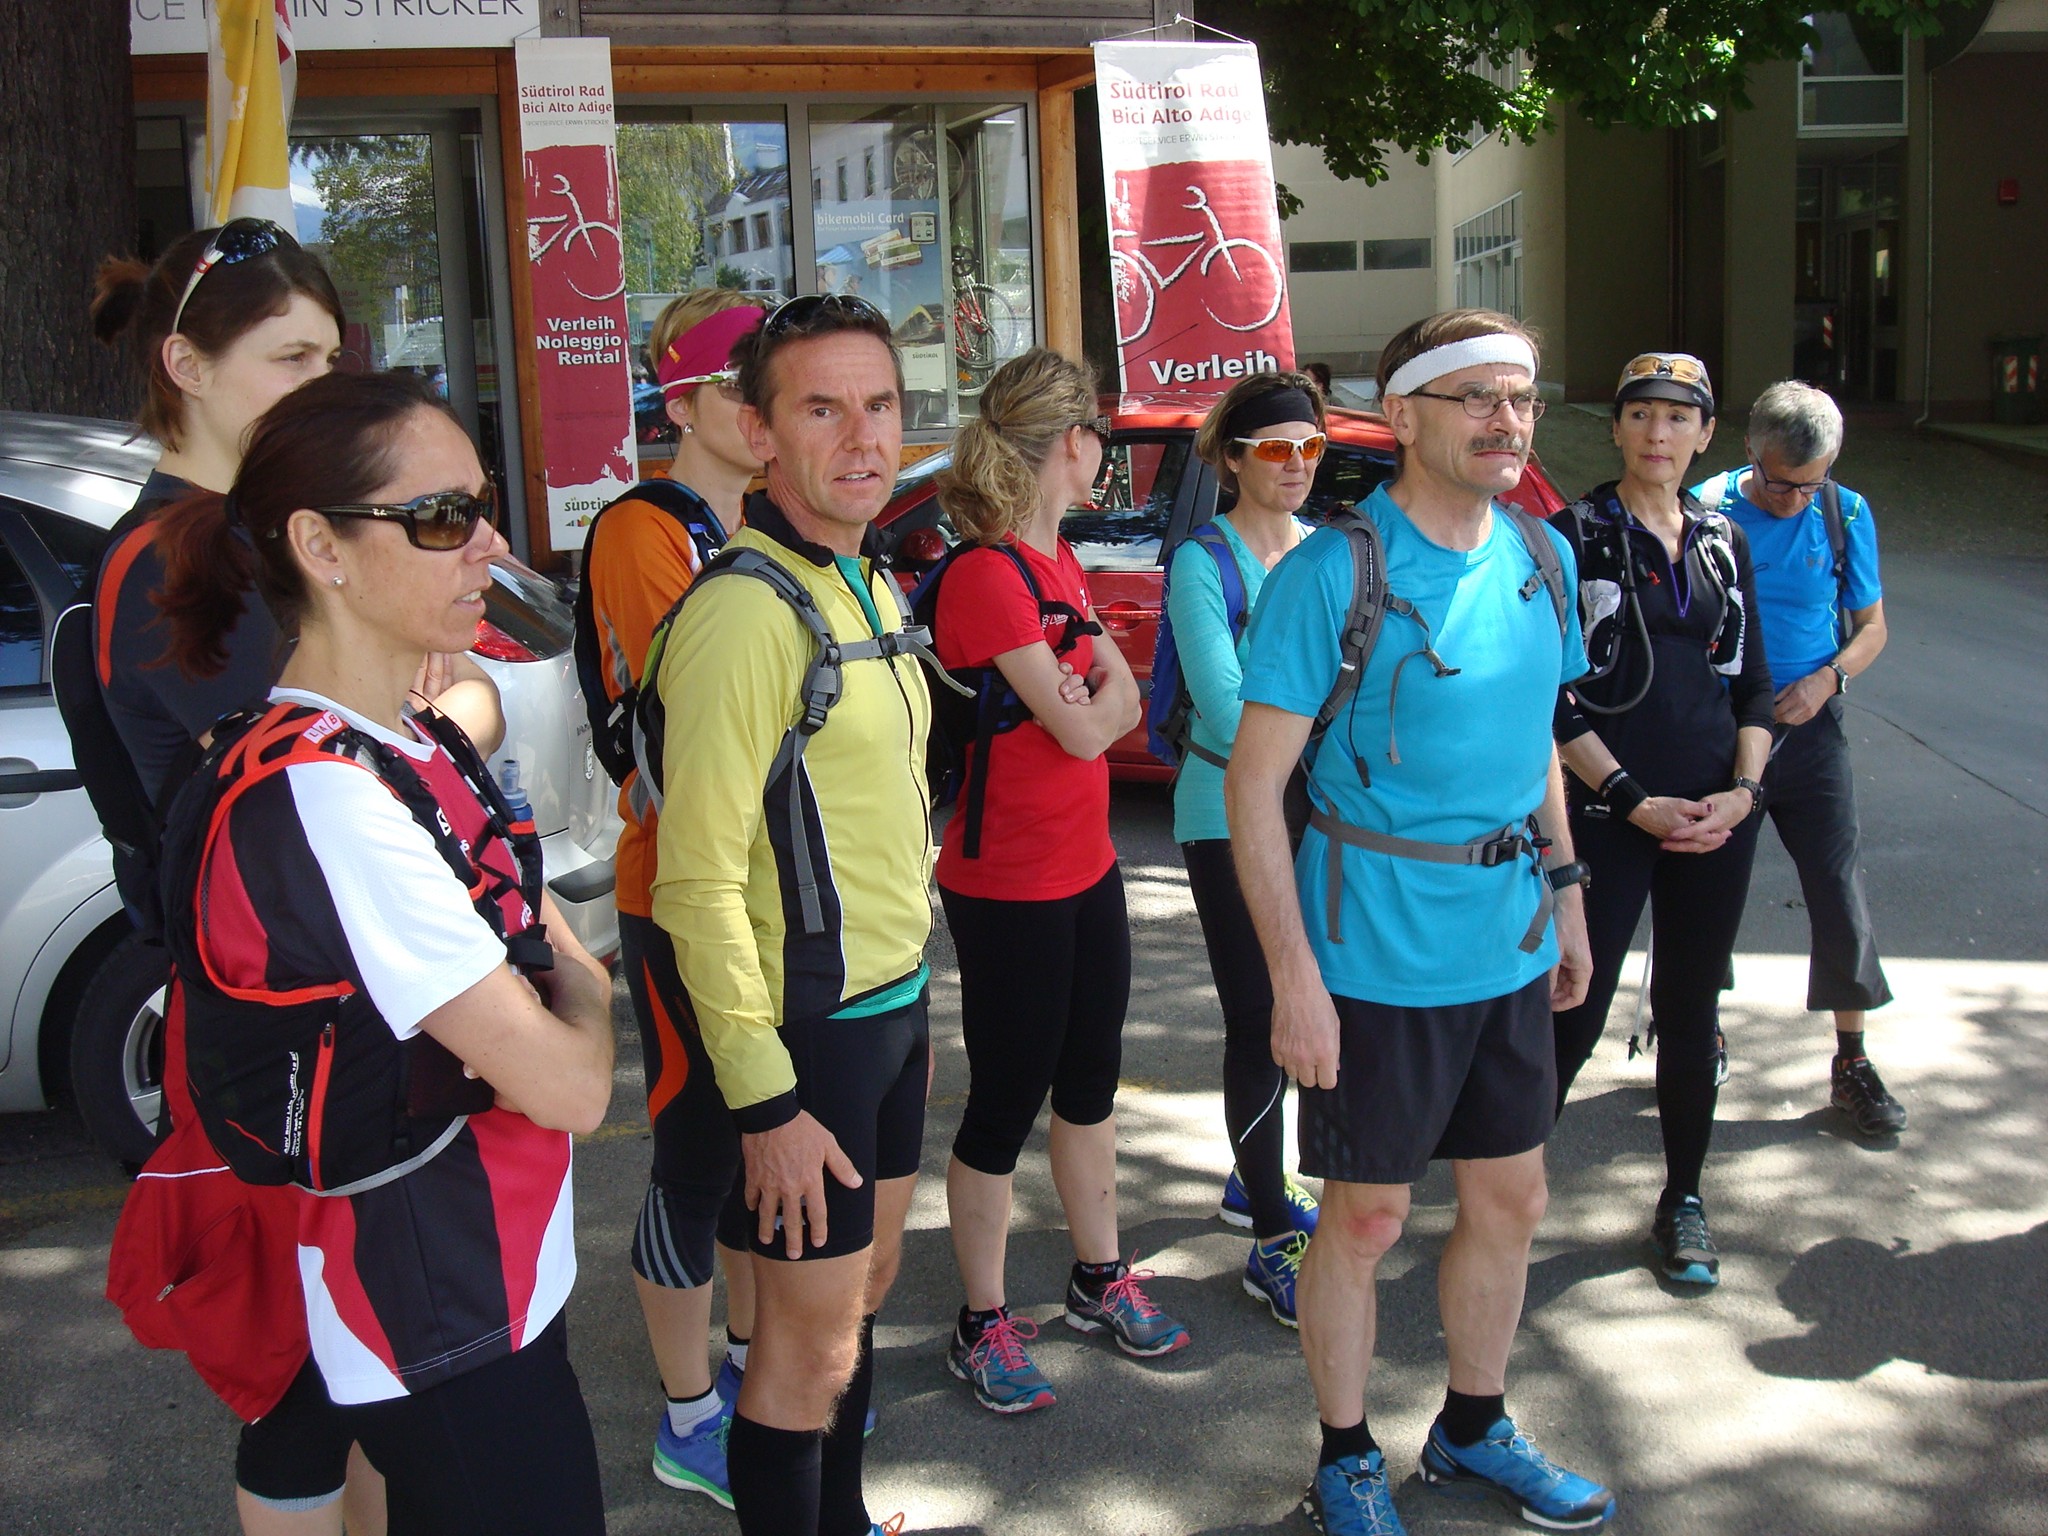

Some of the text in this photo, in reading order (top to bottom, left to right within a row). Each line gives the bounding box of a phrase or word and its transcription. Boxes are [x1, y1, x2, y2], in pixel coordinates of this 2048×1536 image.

[135, 0, 186, 21] CE
[521, 85, 605, 98] Südtirol Rad
[1110, 81, 1239, 100] Südtirol Rad
[522, 101, 612, 114] Bici Alto Adige
[1112, 107, 1251, 124] Bici Alto Adige
[1118, 134, 1177, 146] PORTSERVICE
[817, 212, 904, 225] bikemobil Card
[546, 315, 616, 332] Verleih
[536, 332, 622, 351] Noleggio
[558, 349, 621, 365] Rental
[1149, 350, 1278, 385] Verleih
